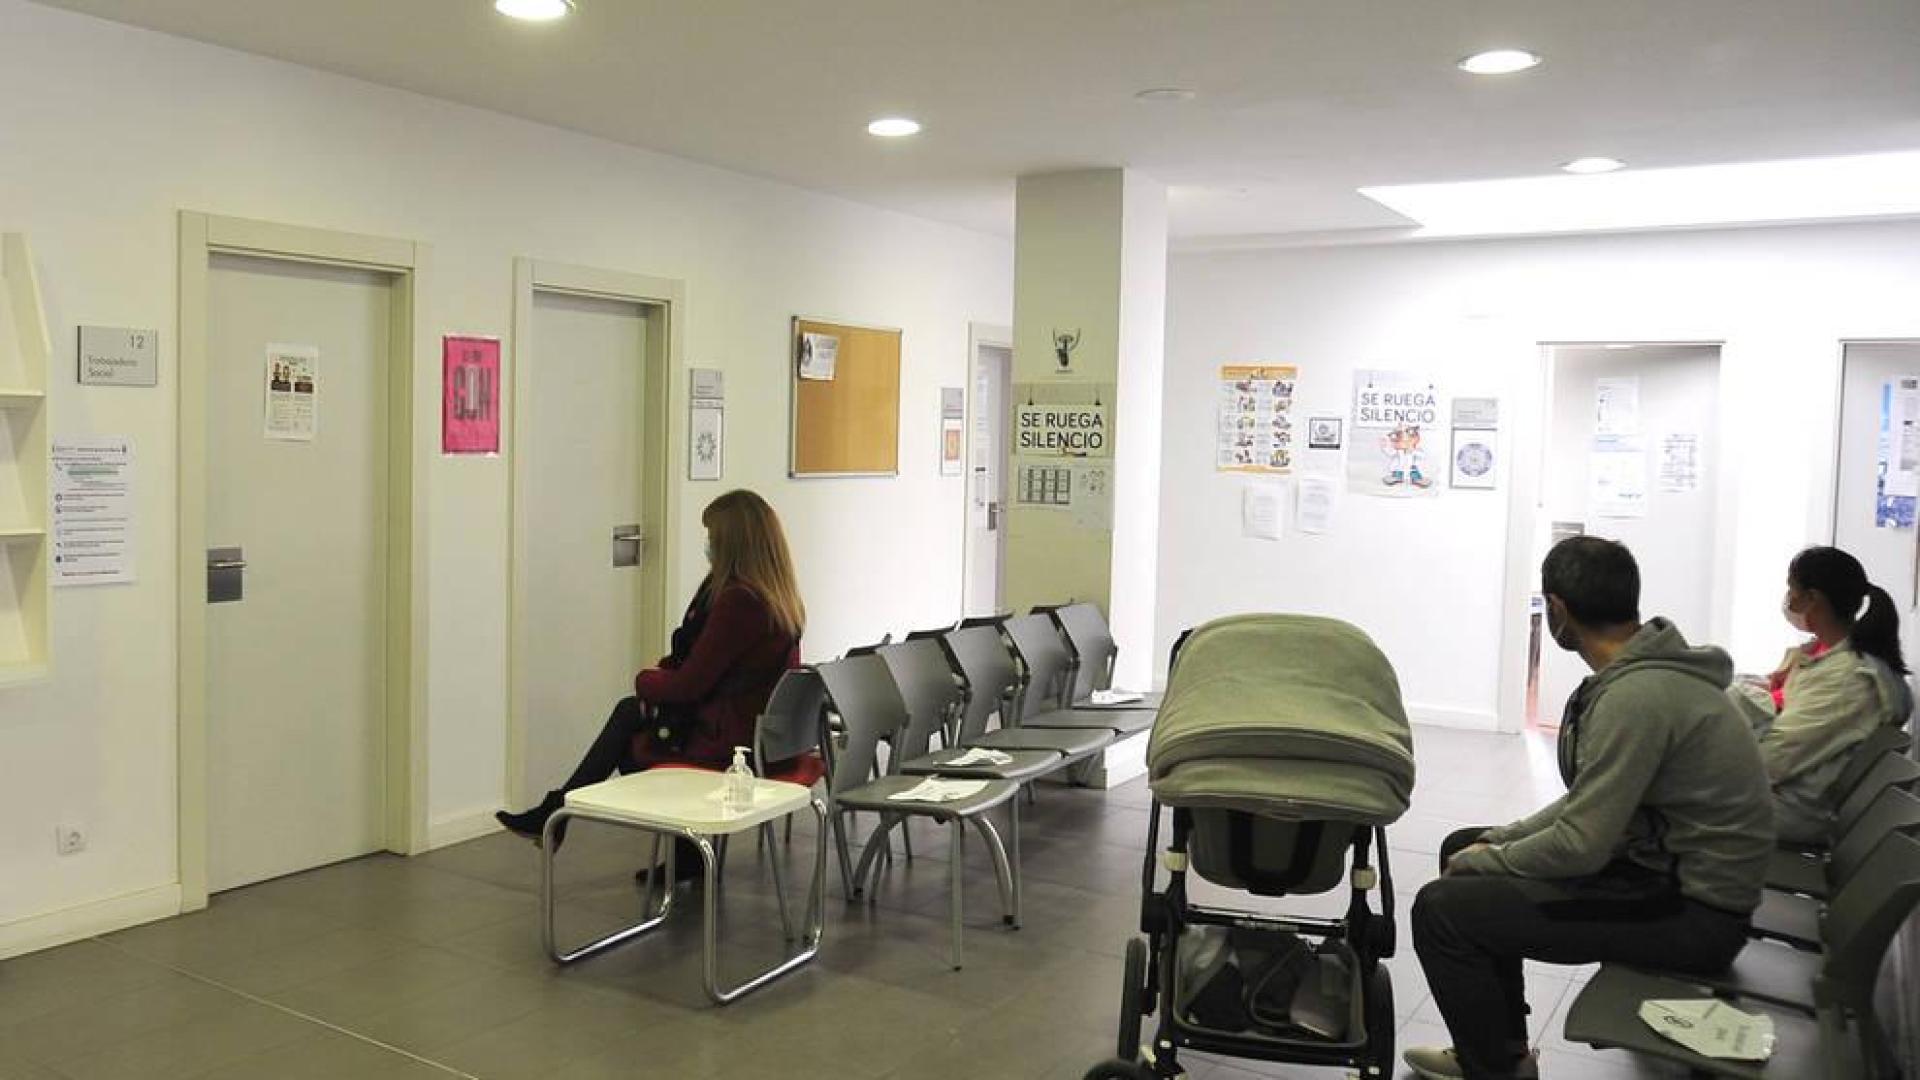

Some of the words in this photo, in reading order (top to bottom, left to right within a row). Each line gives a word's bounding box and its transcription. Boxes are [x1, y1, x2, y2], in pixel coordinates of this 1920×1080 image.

[130, 335, 144, 349] 12
[1361, 393, 1379, 406] SE
[1384, 393, 1435, 407] RUEGA
[1021, 413, 1041, 427] SE
[1046, 413, 1102, 428] RUEGA
[1361, 408, 1435, 423] SILENCIO
[1020, 432, 1102, 449] SILENCIO
